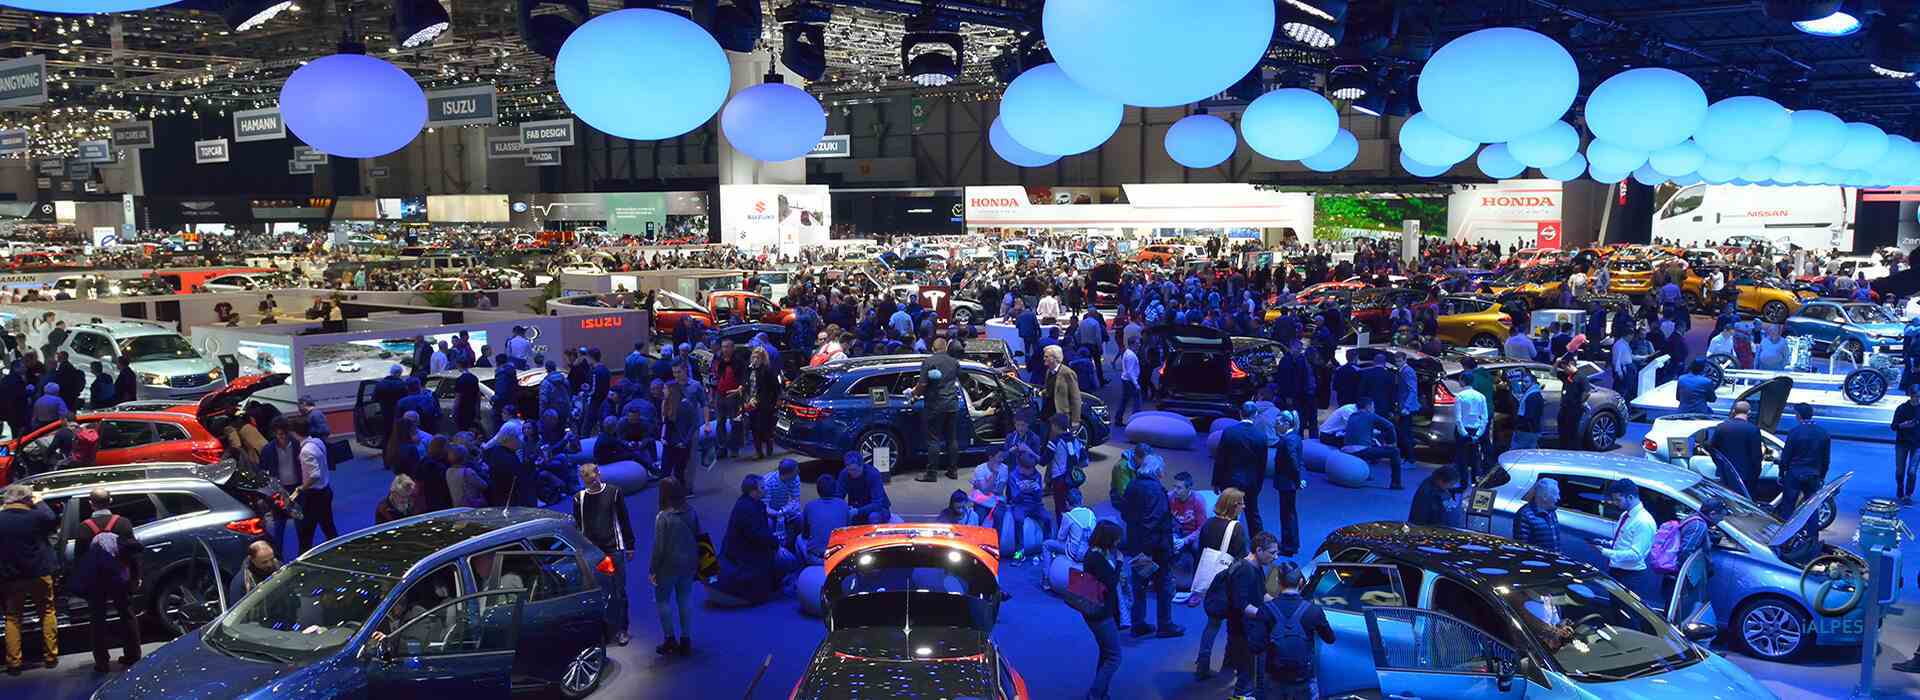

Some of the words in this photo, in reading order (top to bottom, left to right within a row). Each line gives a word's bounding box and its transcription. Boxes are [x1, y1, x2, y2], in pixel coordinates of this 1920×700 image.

[0, 71, 40, 92] ANGYONG
[442, 99, 476, 115] ISUZU
[241, 117, 277, 133] HAMANN
[526, 129, 540, 140] FAB
[541, 127, 567, 138] DESIGN
[200, 146, 223, 158] TOPCAR
[812, 141, 838, 151] UZUKI
[970, 197, 1020, 208] HONDA
[1481, 196, 1554, 207] HONDA
[1746, 209, 1789, 217] NISSAN
[581, 316, 622, 329] ISUZU
